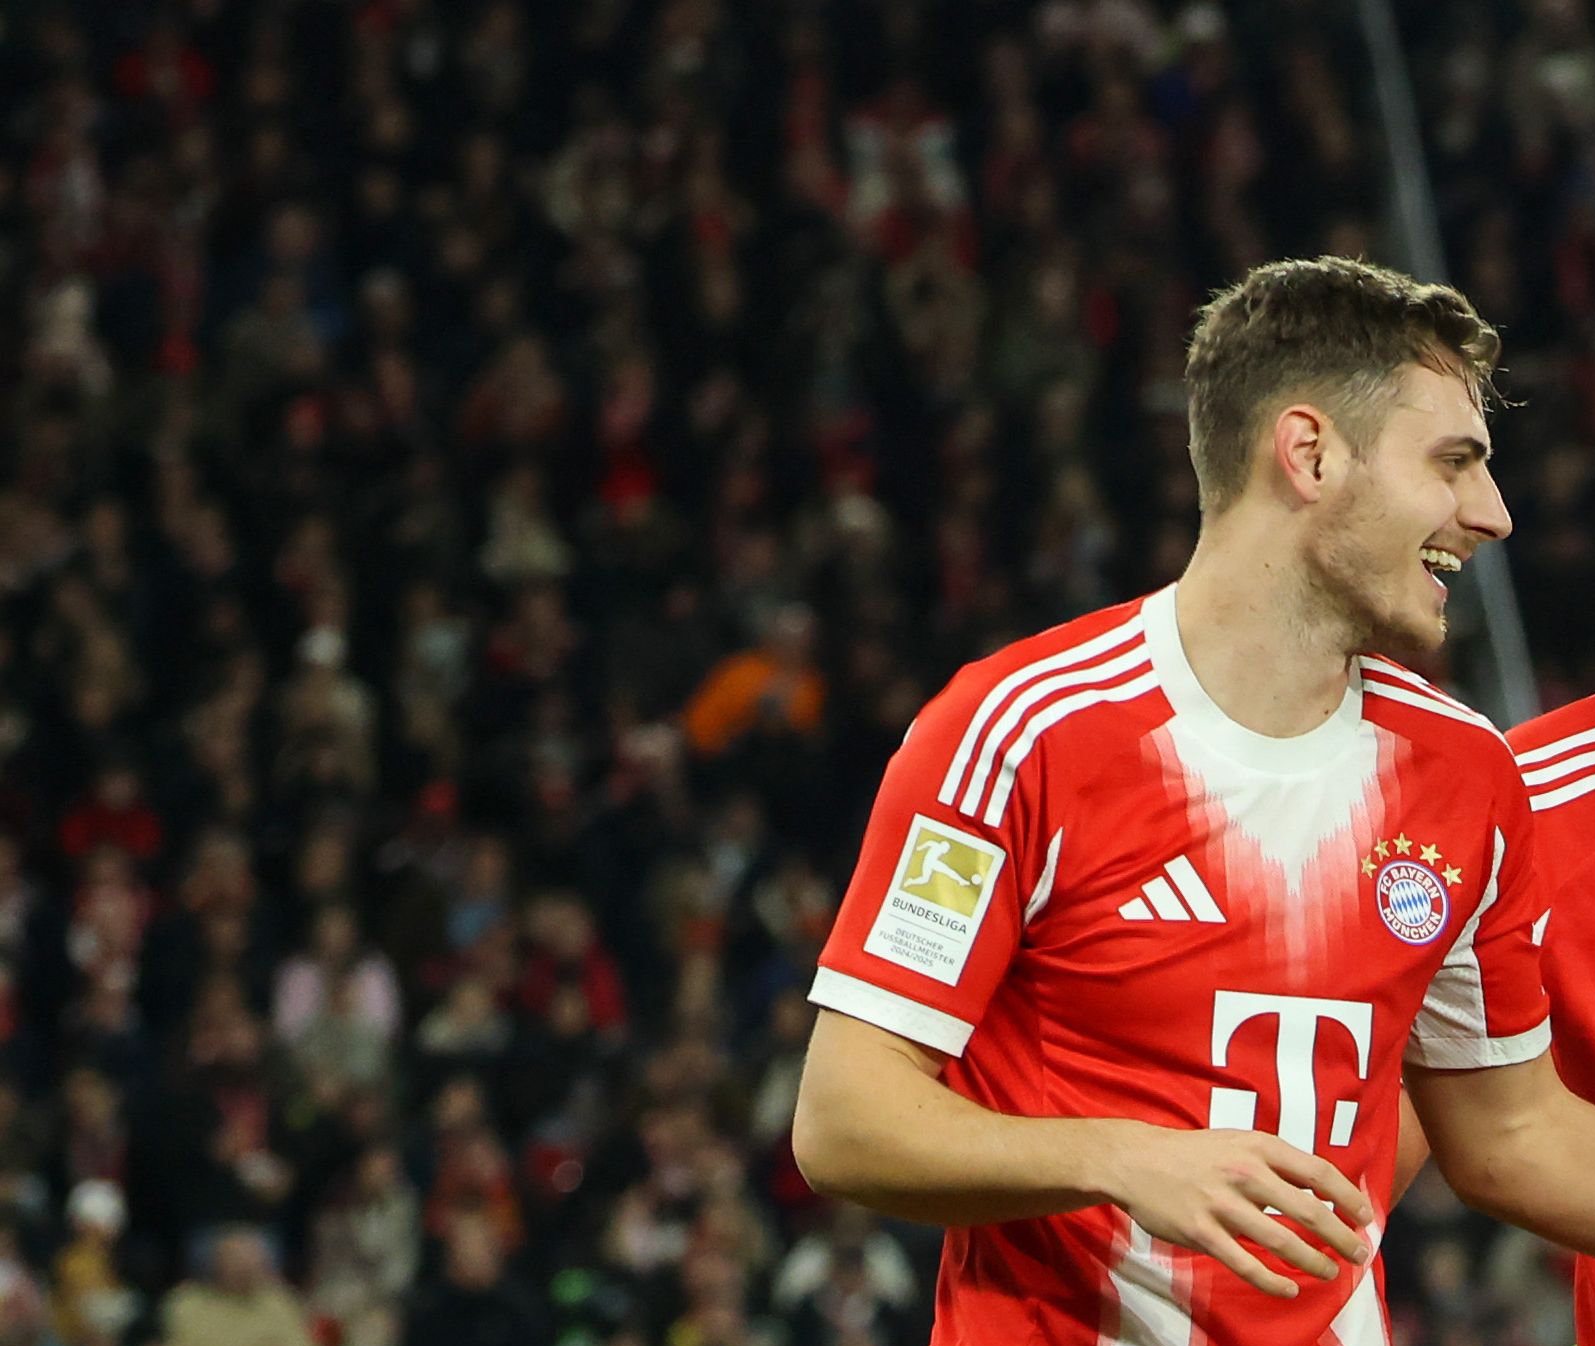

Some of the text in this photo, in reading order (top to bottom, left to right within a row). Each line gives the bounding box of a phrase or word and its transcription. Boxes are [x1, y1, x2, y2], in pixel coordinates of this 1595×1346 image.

[1381, 867, 1440, 899] FC BAYERN
[892, 897, 967, 934] BUNDESLIGA
[896, 928, 943, 951] DEUTSCHER
[891, 945, 933, 967] 2024/2025
[1209, 990, 1373, 1215] T
